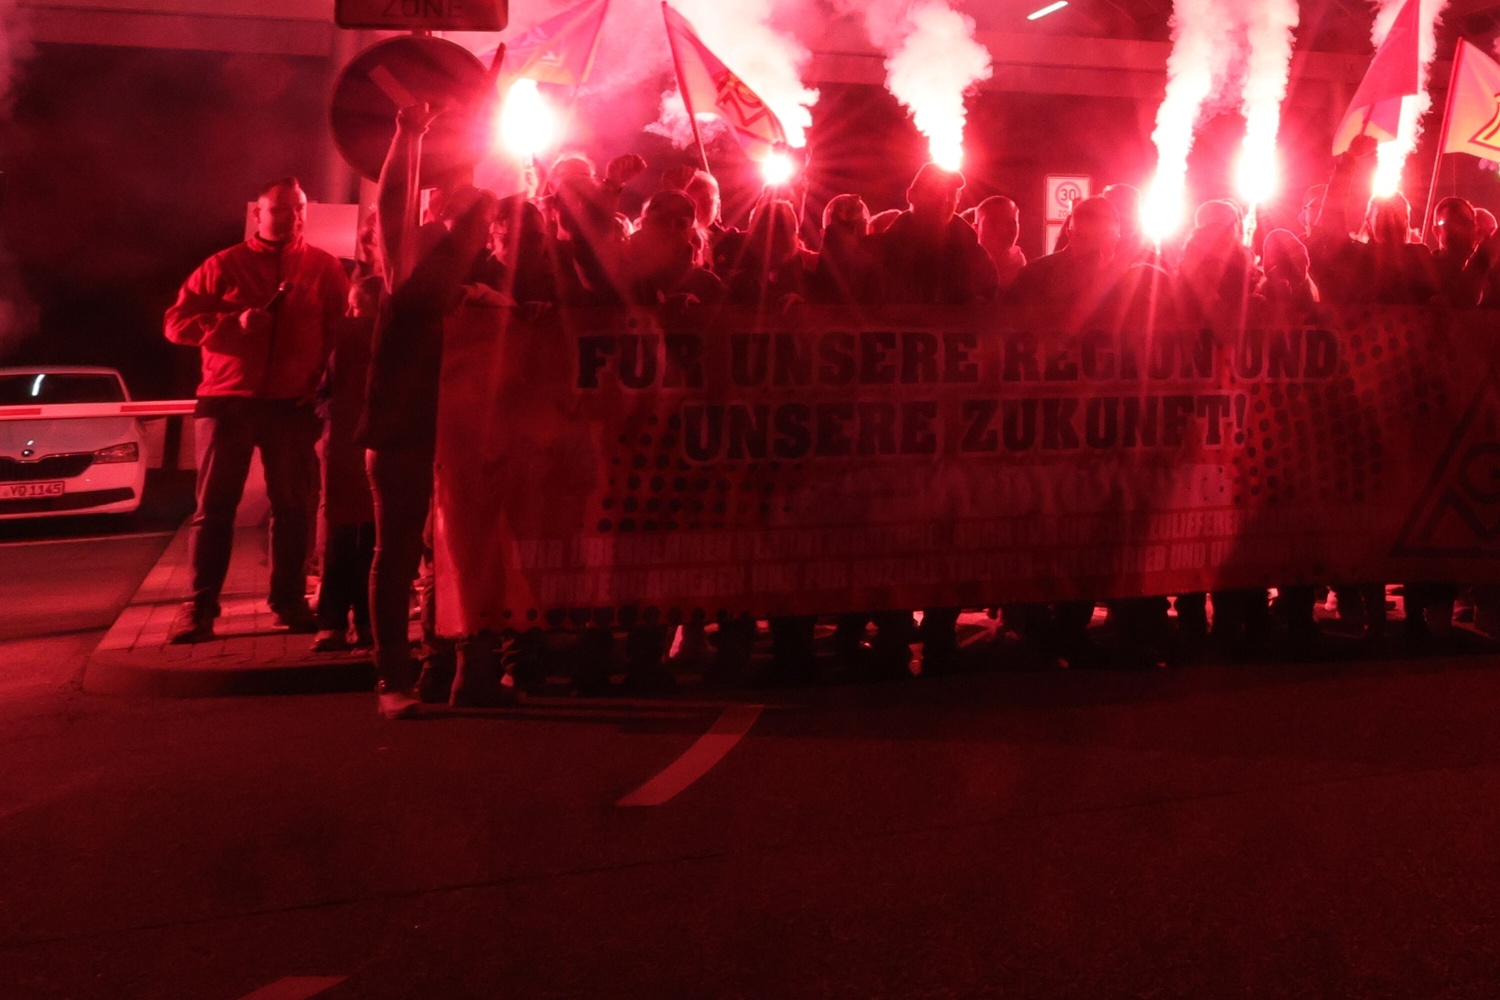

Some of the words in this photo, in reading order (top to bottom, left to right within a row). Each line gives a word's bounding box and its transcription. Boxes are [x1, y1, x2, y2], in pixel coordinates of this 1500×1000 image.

[1060, 189, 1075, 201] 30
[577, 316, 706, 390] FÜR
[730, 330, 980, 388] UNSERE
[1236, 327, 1339, 381] UND
[685, 400, 939, 462] UNSERE
[961, 394, 1247, 456] ZUKUNFT!
